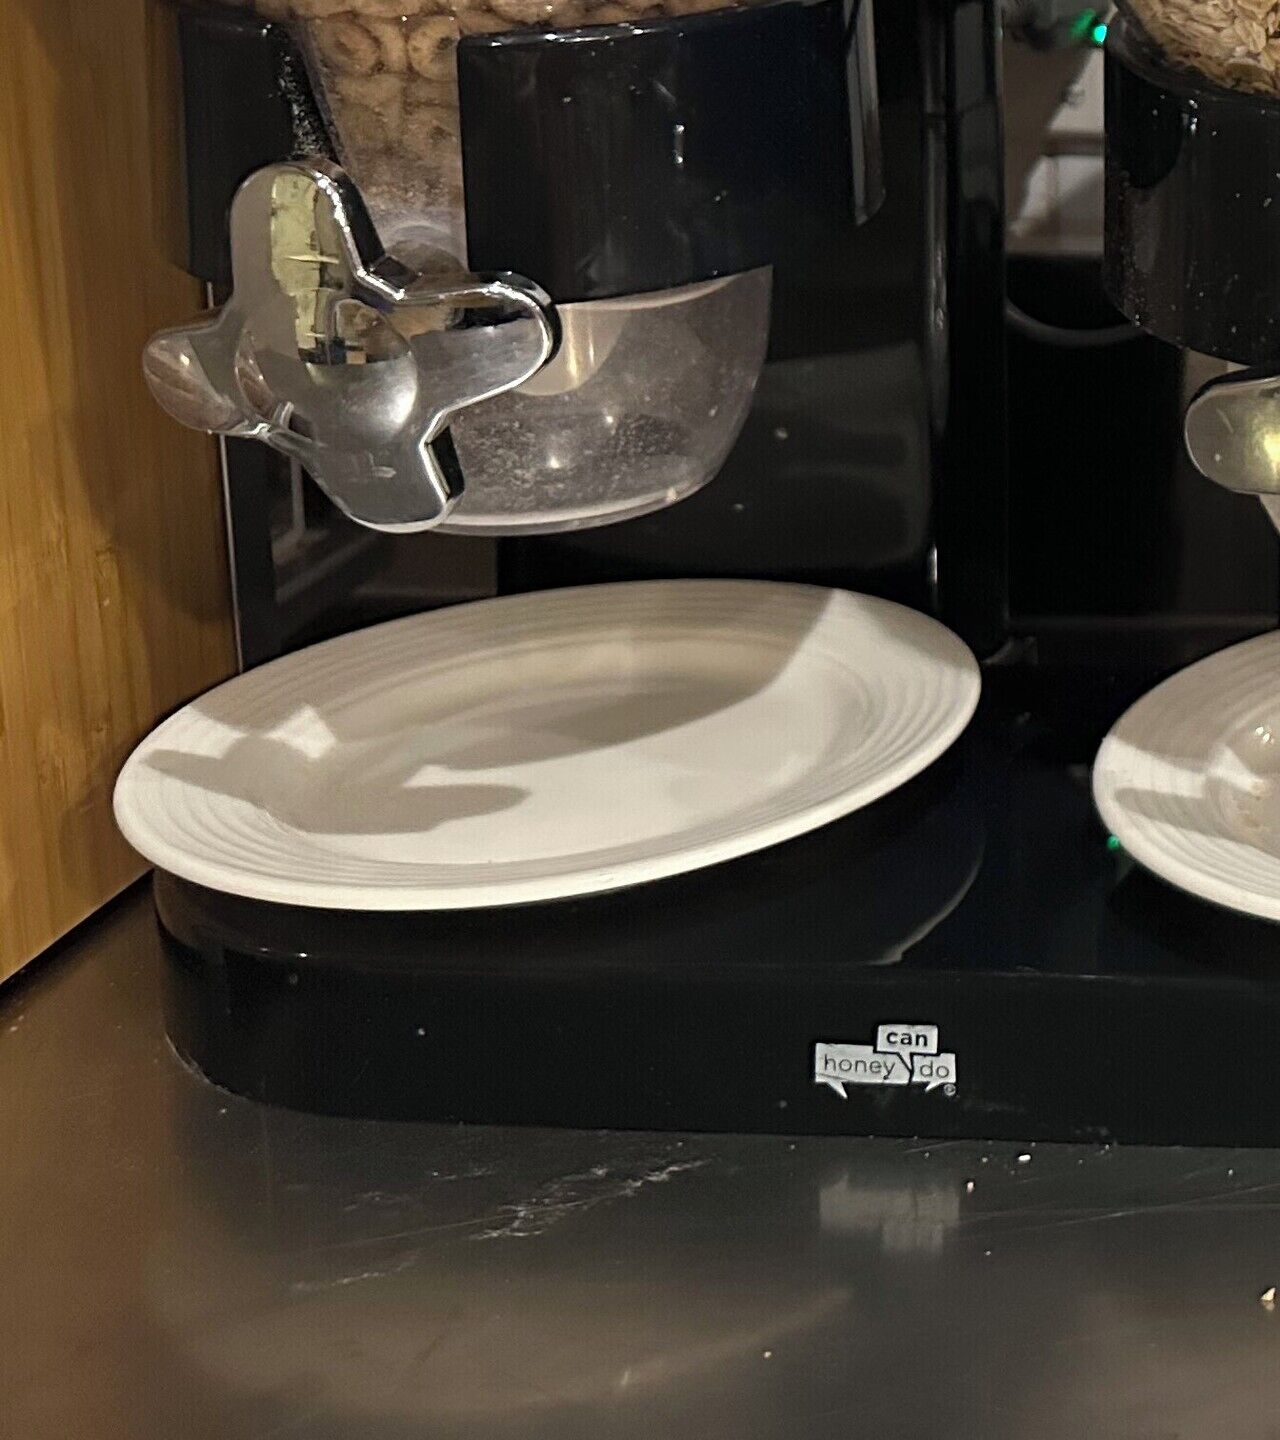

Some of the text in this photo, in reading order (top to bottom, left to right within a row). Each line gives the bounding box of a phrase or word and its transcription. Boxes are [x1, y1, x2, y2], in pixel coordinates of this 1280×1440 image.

[886, 1030, 929, 1047] can
[823, 1053, 950, 1081] honey do
